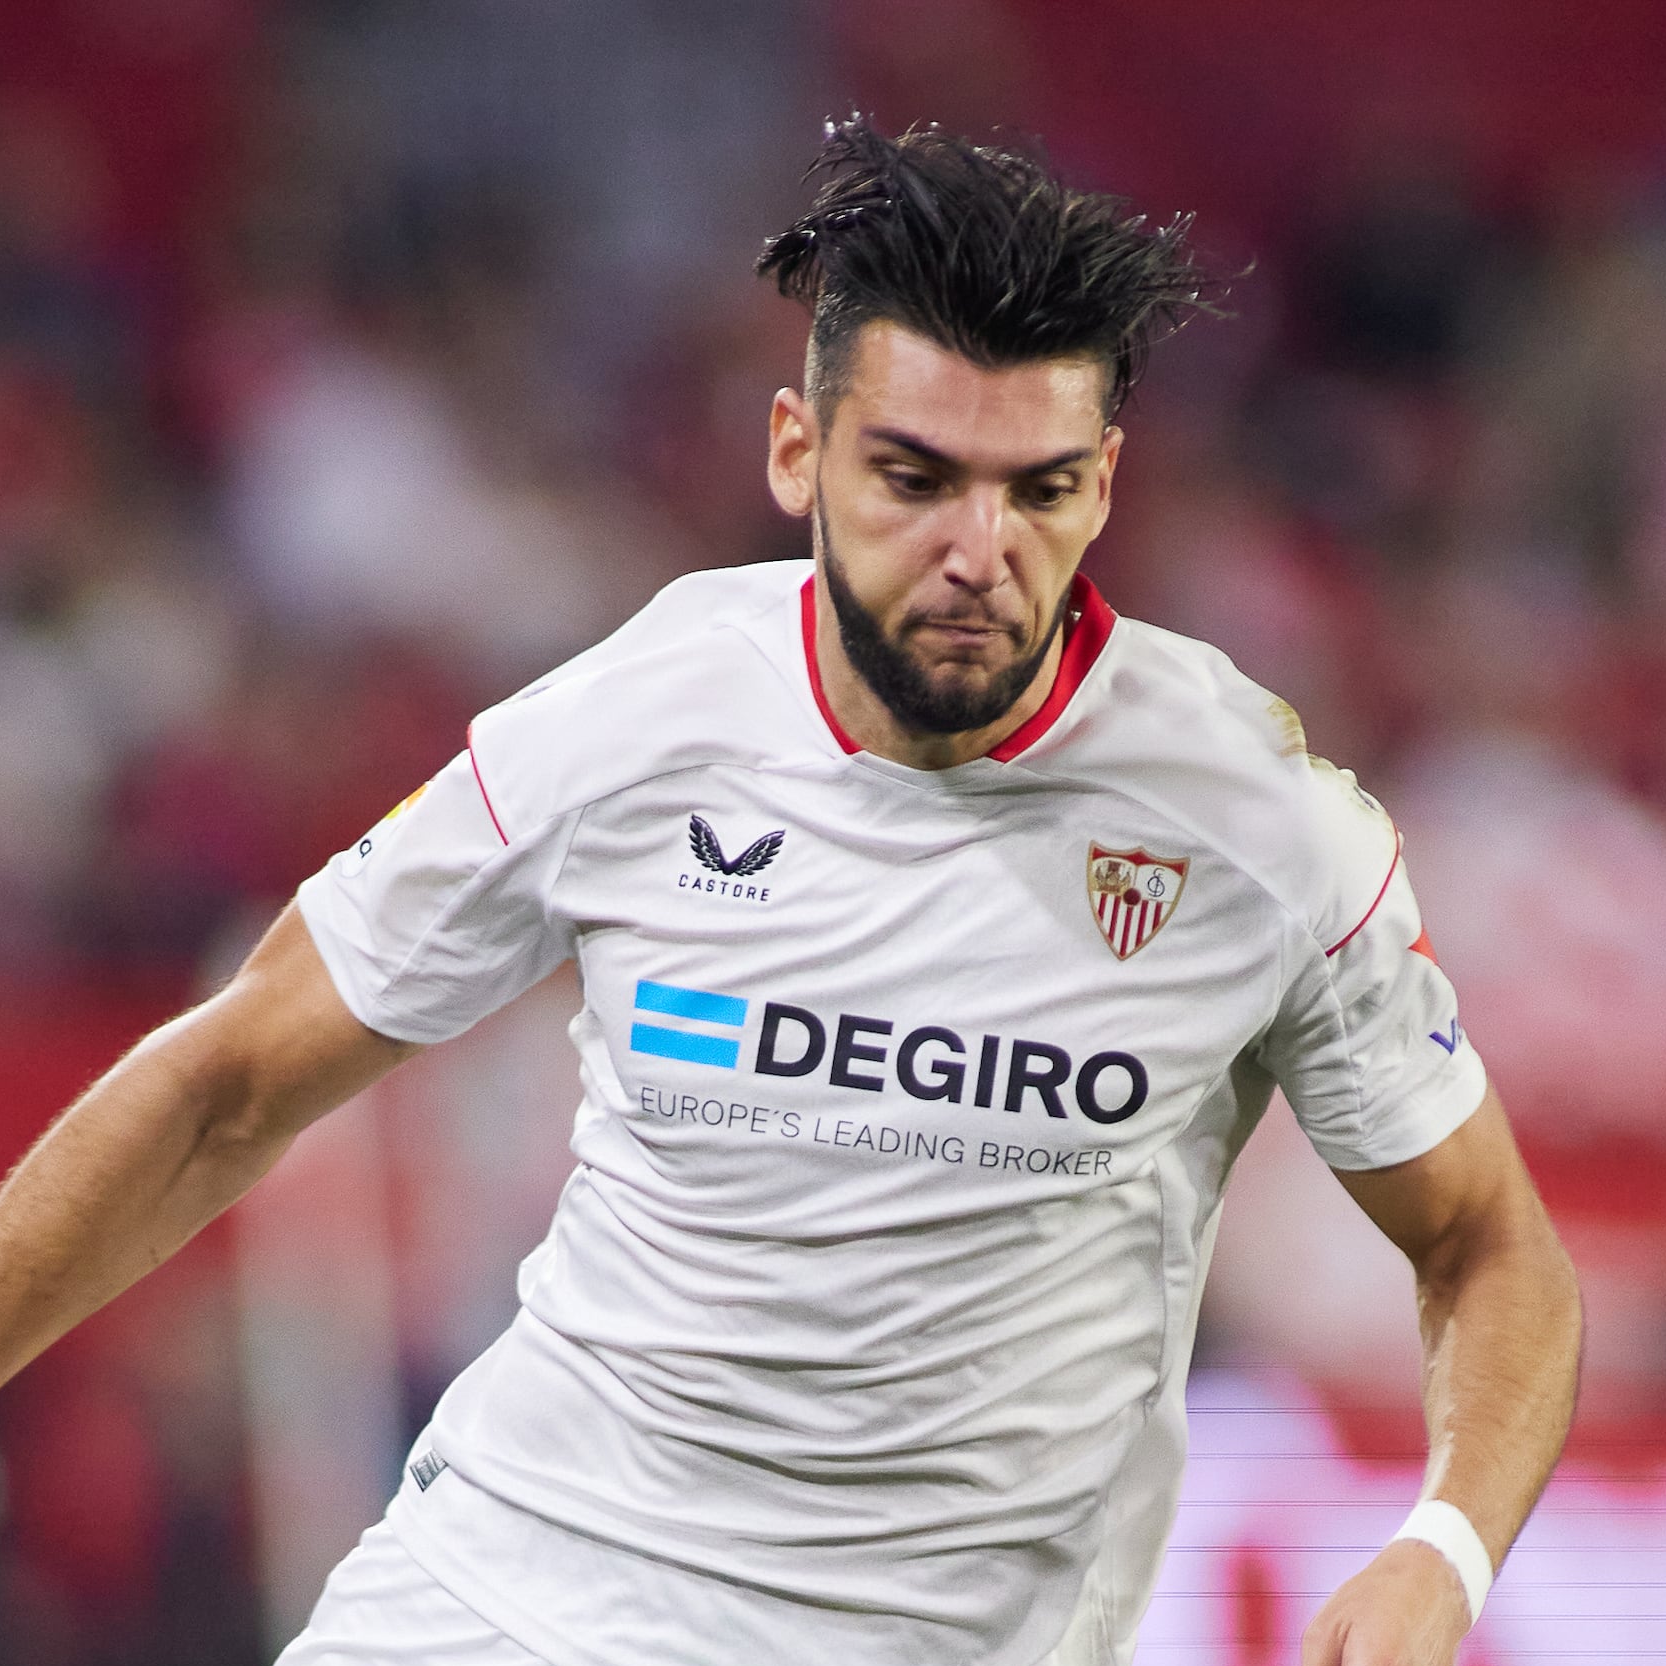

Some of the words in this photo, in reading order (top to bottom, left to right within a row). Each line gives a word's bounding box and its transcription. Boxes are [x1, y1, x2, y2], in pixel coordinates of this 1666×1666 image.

[678, 873, 771, 902] CASTORE
[754, 1001, 1150, 1125] DEGIRO
[814, 1118, 965, 1164] LEADING
[979, 1141, 1113, 1176] BROKER
